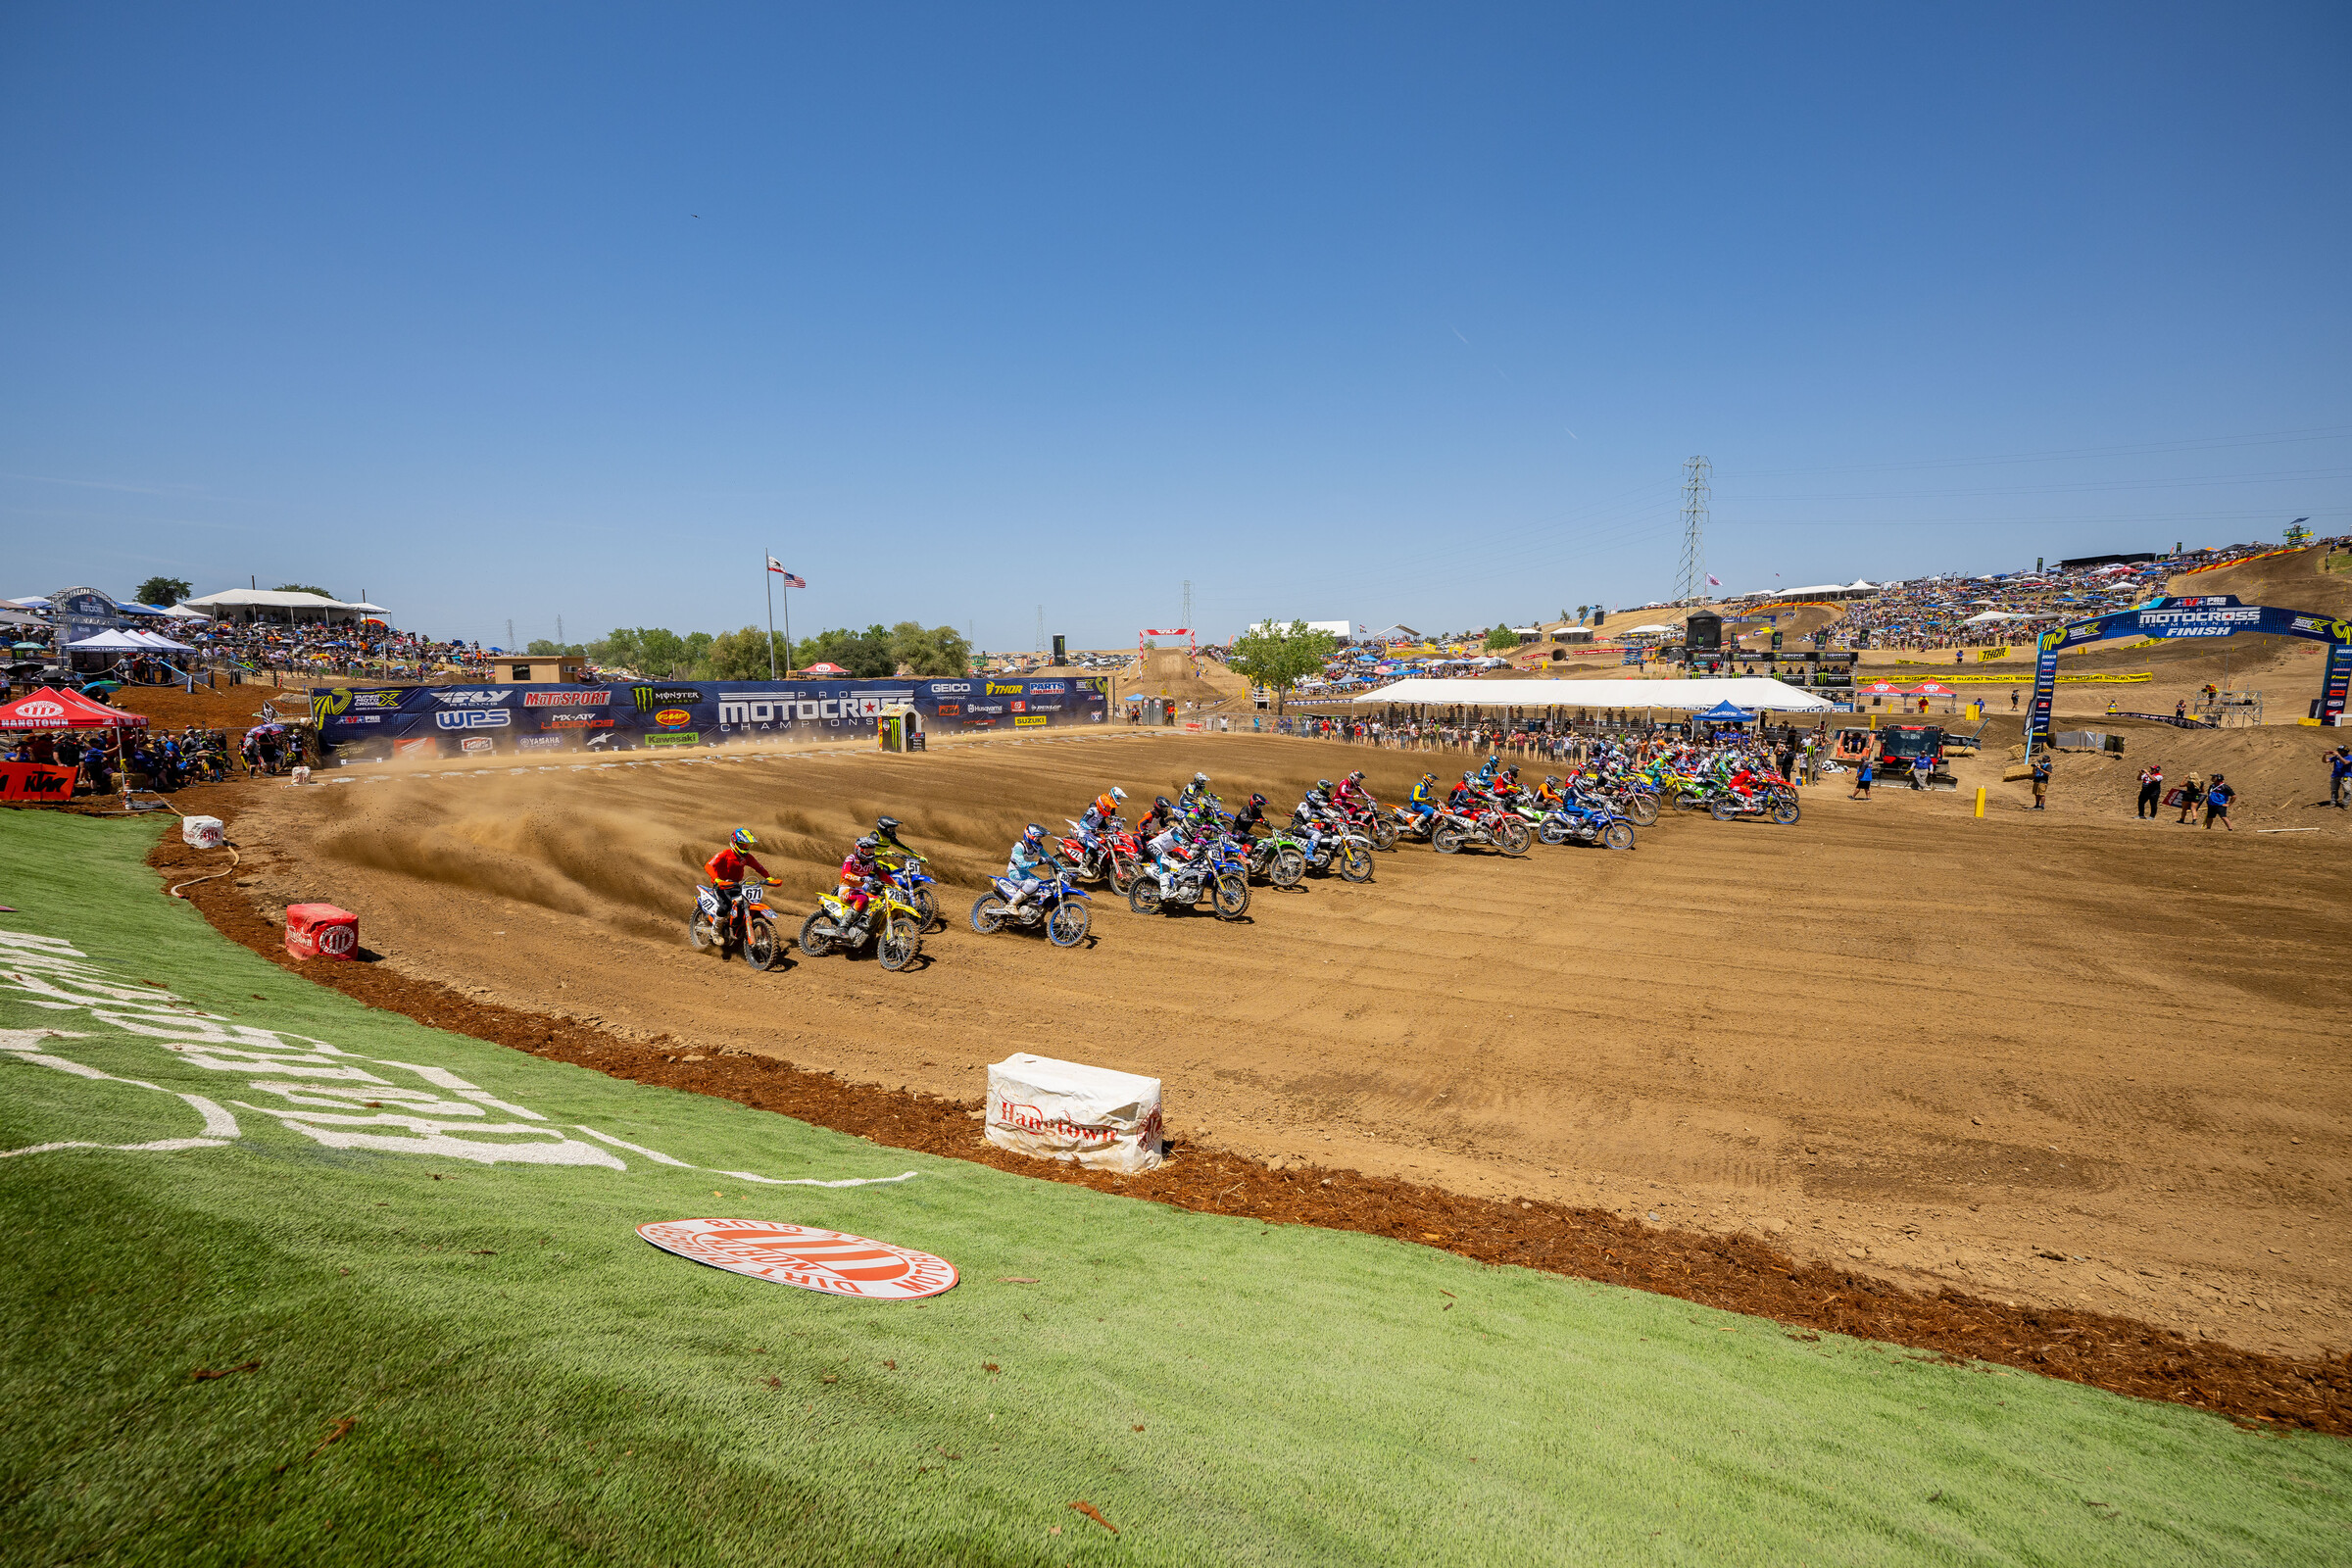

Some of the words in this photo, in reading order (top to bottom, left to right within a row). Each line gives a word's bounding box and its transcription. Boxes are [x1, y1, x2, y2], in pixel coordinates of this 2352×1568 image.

[2138, 611, 2261, 624] MOTOCROSS
[2166, 626, 2231, 636] FINISH
[1983, 647, 2007, 661] THOR
[931, 683, 971, 693] GEICO
[995, 685, 1024, 695] THOR
[429, 690, 514, 704] FLY
[655, 691, 700, 700] MONSTER
[436, 709, 512, 730] WPS
[540, 719, 615, 730] LEGENDS
[648, 734, 696, 743] Kawasaki
[23, 770, 69, 793] KTM
[745, 888, 761, 900] 671
[889, 889, 903, 902] 281
[998, 1094, 1120, 1143] Hangtown
[704, 1219, 804, 1234] CLUB
[702, 1239, 820, 1271] NORTH
[748, 1266, 864, 1295] DIRT
